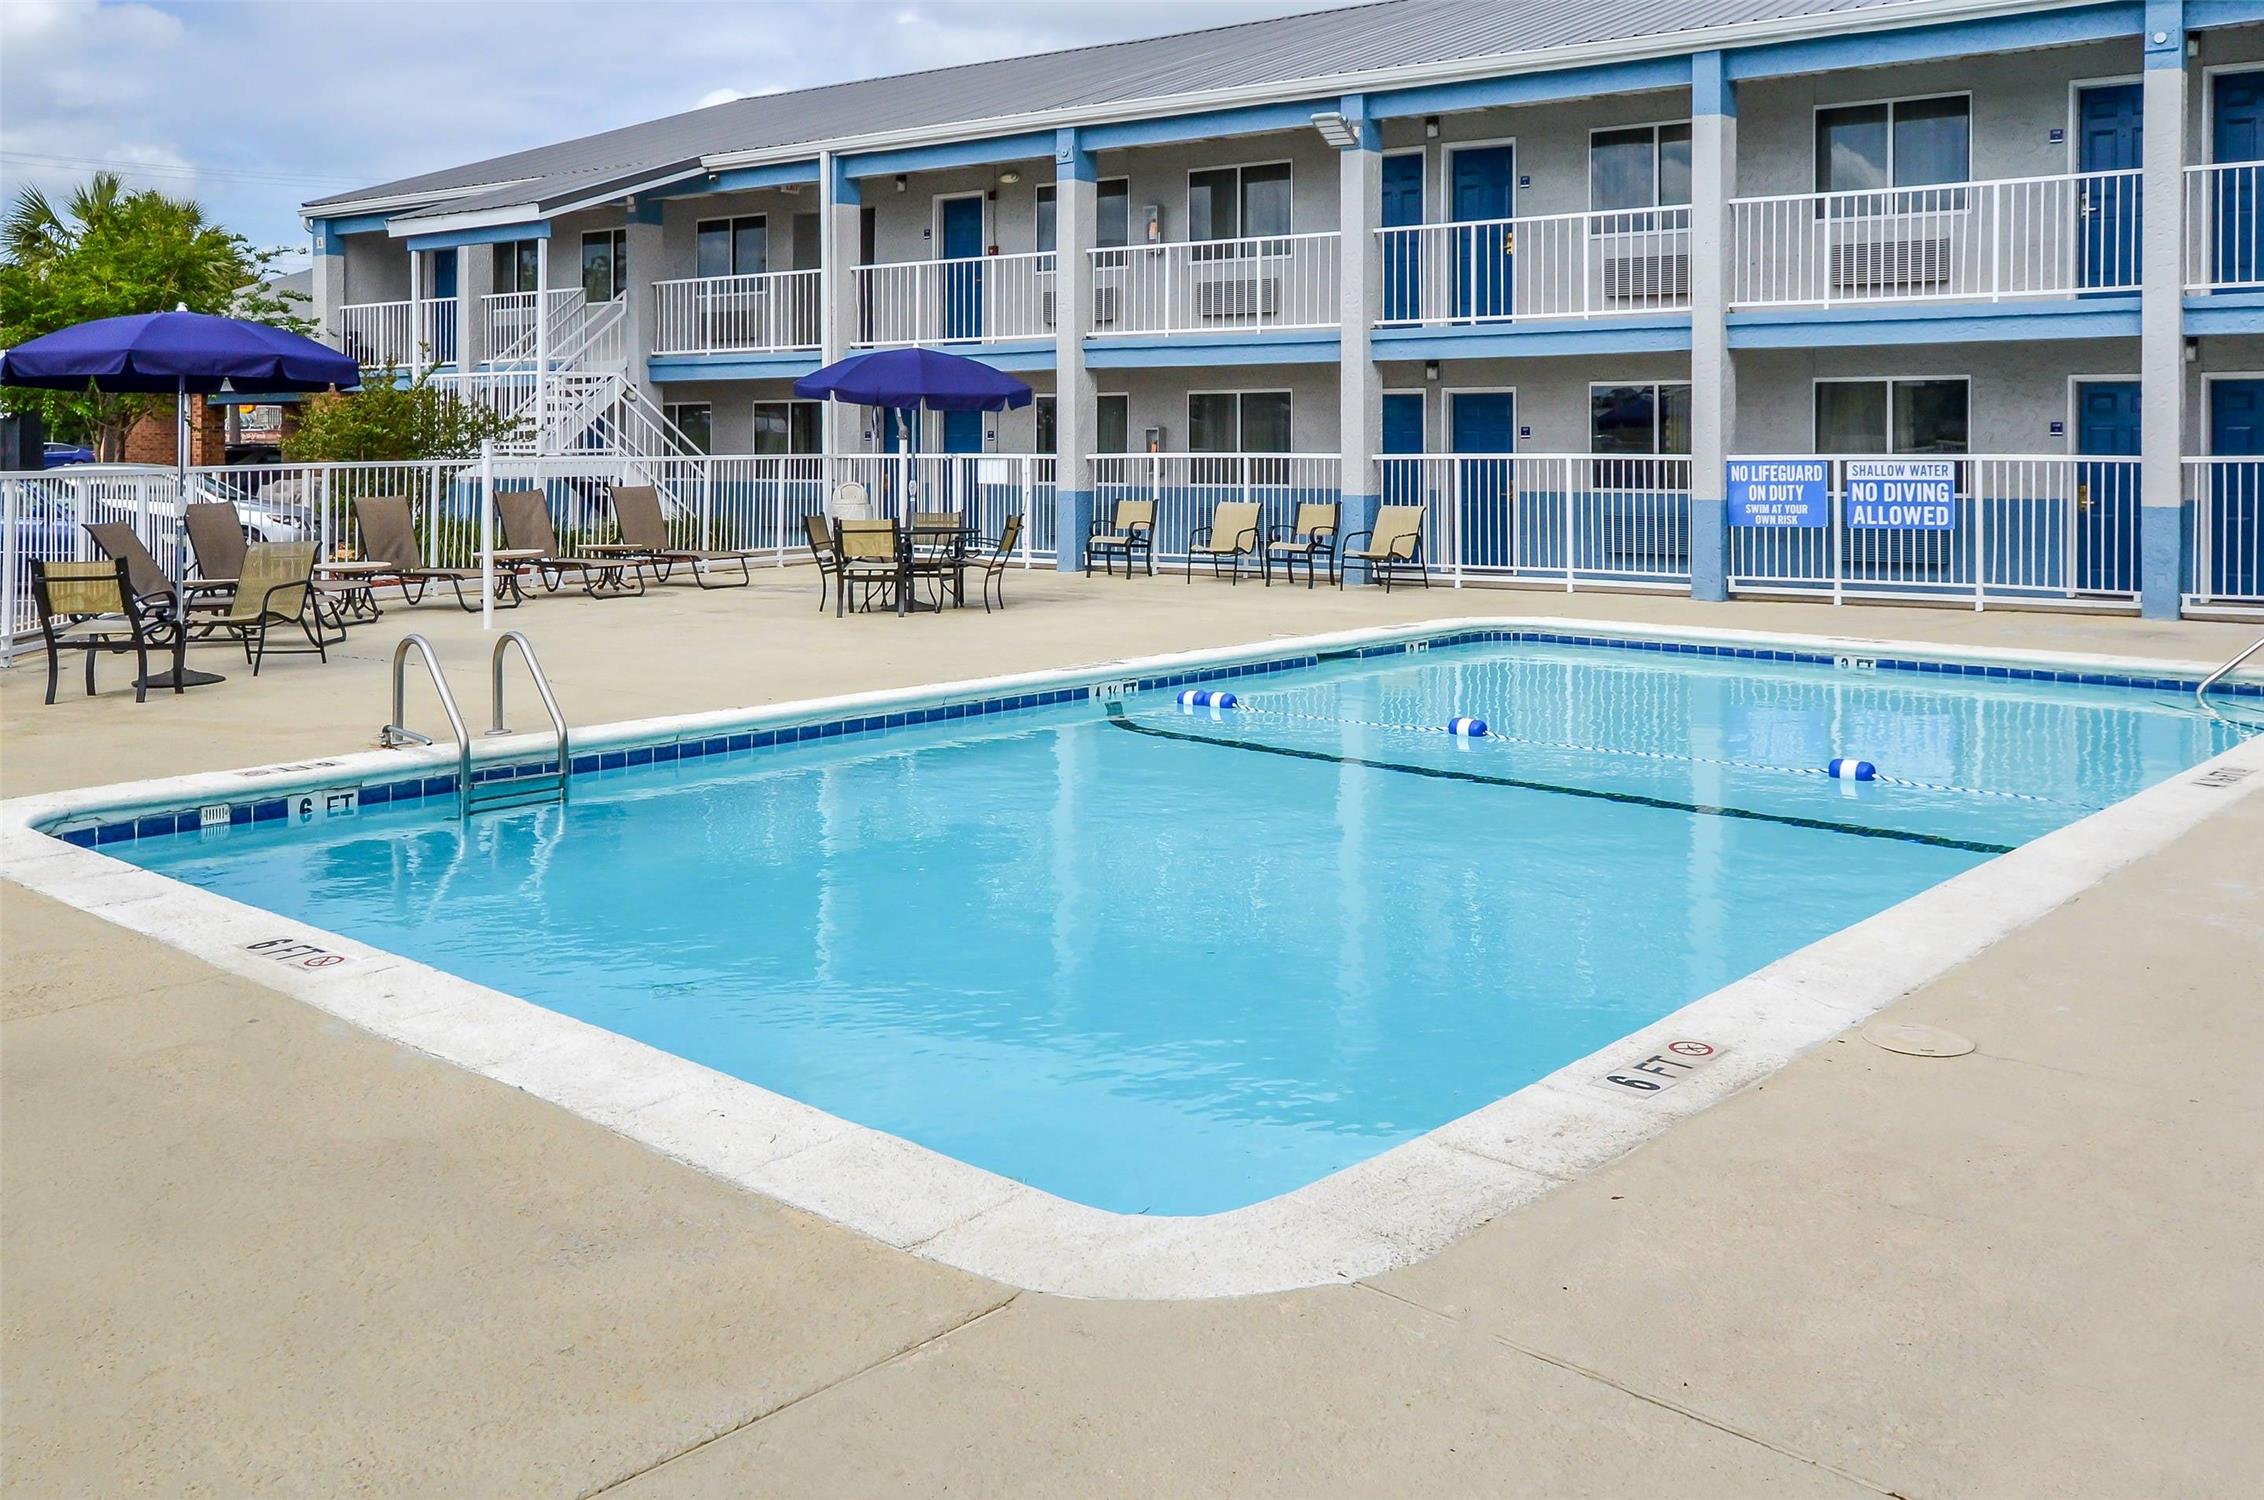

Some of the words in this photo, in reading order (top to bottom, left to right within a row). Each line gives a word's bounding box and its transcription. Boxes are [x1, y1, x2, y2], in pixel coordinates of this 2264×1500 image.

[1730, 465, 1748, 482] NO
[1751, 465, 1823, 482] LIFEGUARD
[1852, 464, 1905, 476] SHALLOW
[1909, 464, 1949, 476] WATER
[1748, 485, 1766, 501] ON
[1769, 485, 1804, 501] DUTY
[1851, 482, 1878, 502] NO
[1884, 482, 1949, 502] DIVING
[1745, 504, 1770, 514] SWIM
[1771, 504, 1783, 514] AT
[1784, 504, 1808, 515] YOUR
[1853, 505, 1949, 526] ALLOWED
[1755, 515, 1776, 525] OWN
[1777, 515, 1798, 525] RISK
[299, 797, 313, 814] 6
[326, 793, 355, 810] FT
[246, 939, 294, 949] 6
[261, 945, 326, 960] FT
[1633, 1055, 1694, 1078] FT
[1606, 1075, 1661, 1091] 6
